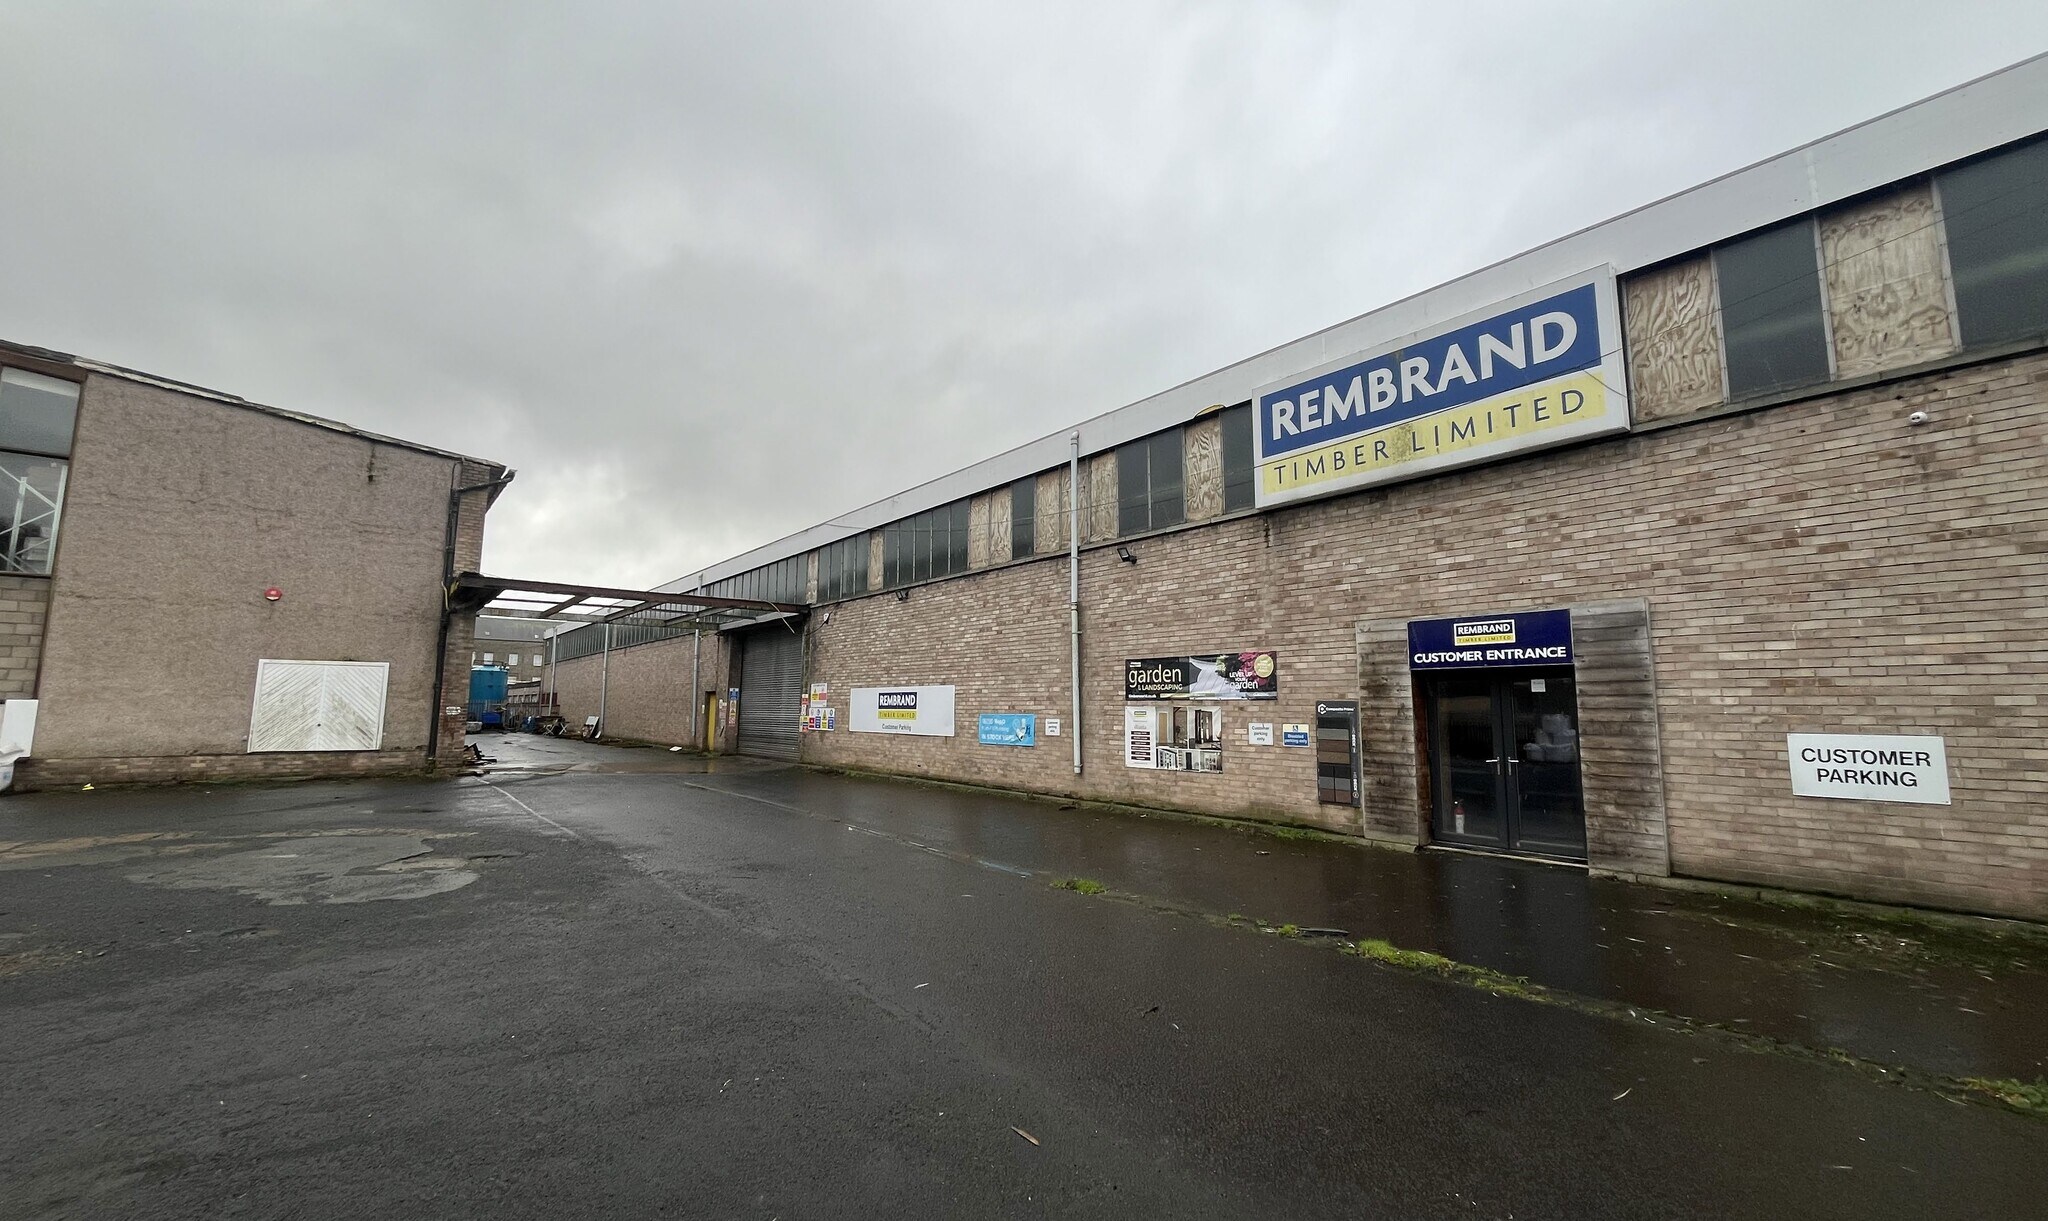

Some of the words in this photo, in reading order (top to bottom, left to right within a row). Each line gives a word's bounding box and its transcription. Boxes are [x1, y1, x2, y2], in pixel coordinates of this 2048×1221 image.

[1272, 310, 1578, 441] REMBRAND
[1274, 439, 1390, 484] TIMBER
[1412, 389, 1585, 452] LIMITED
[1457, 623, 1511, 635] REMBRAND
[1414, 650, 1483, 664] CUSTOMER
[1487, 647, 1567, 661] ENTRANCE
[1128, 664, 1182, 688] garden
[1229, 679, 1259, 691] garden
[879, 694, 916, 706] REMBRAND
[899, 724, 912, 732] Parking
[1801, 748, 1931, 767] CUSTOMER
[1817, 768, 1918, 787] PARKING
